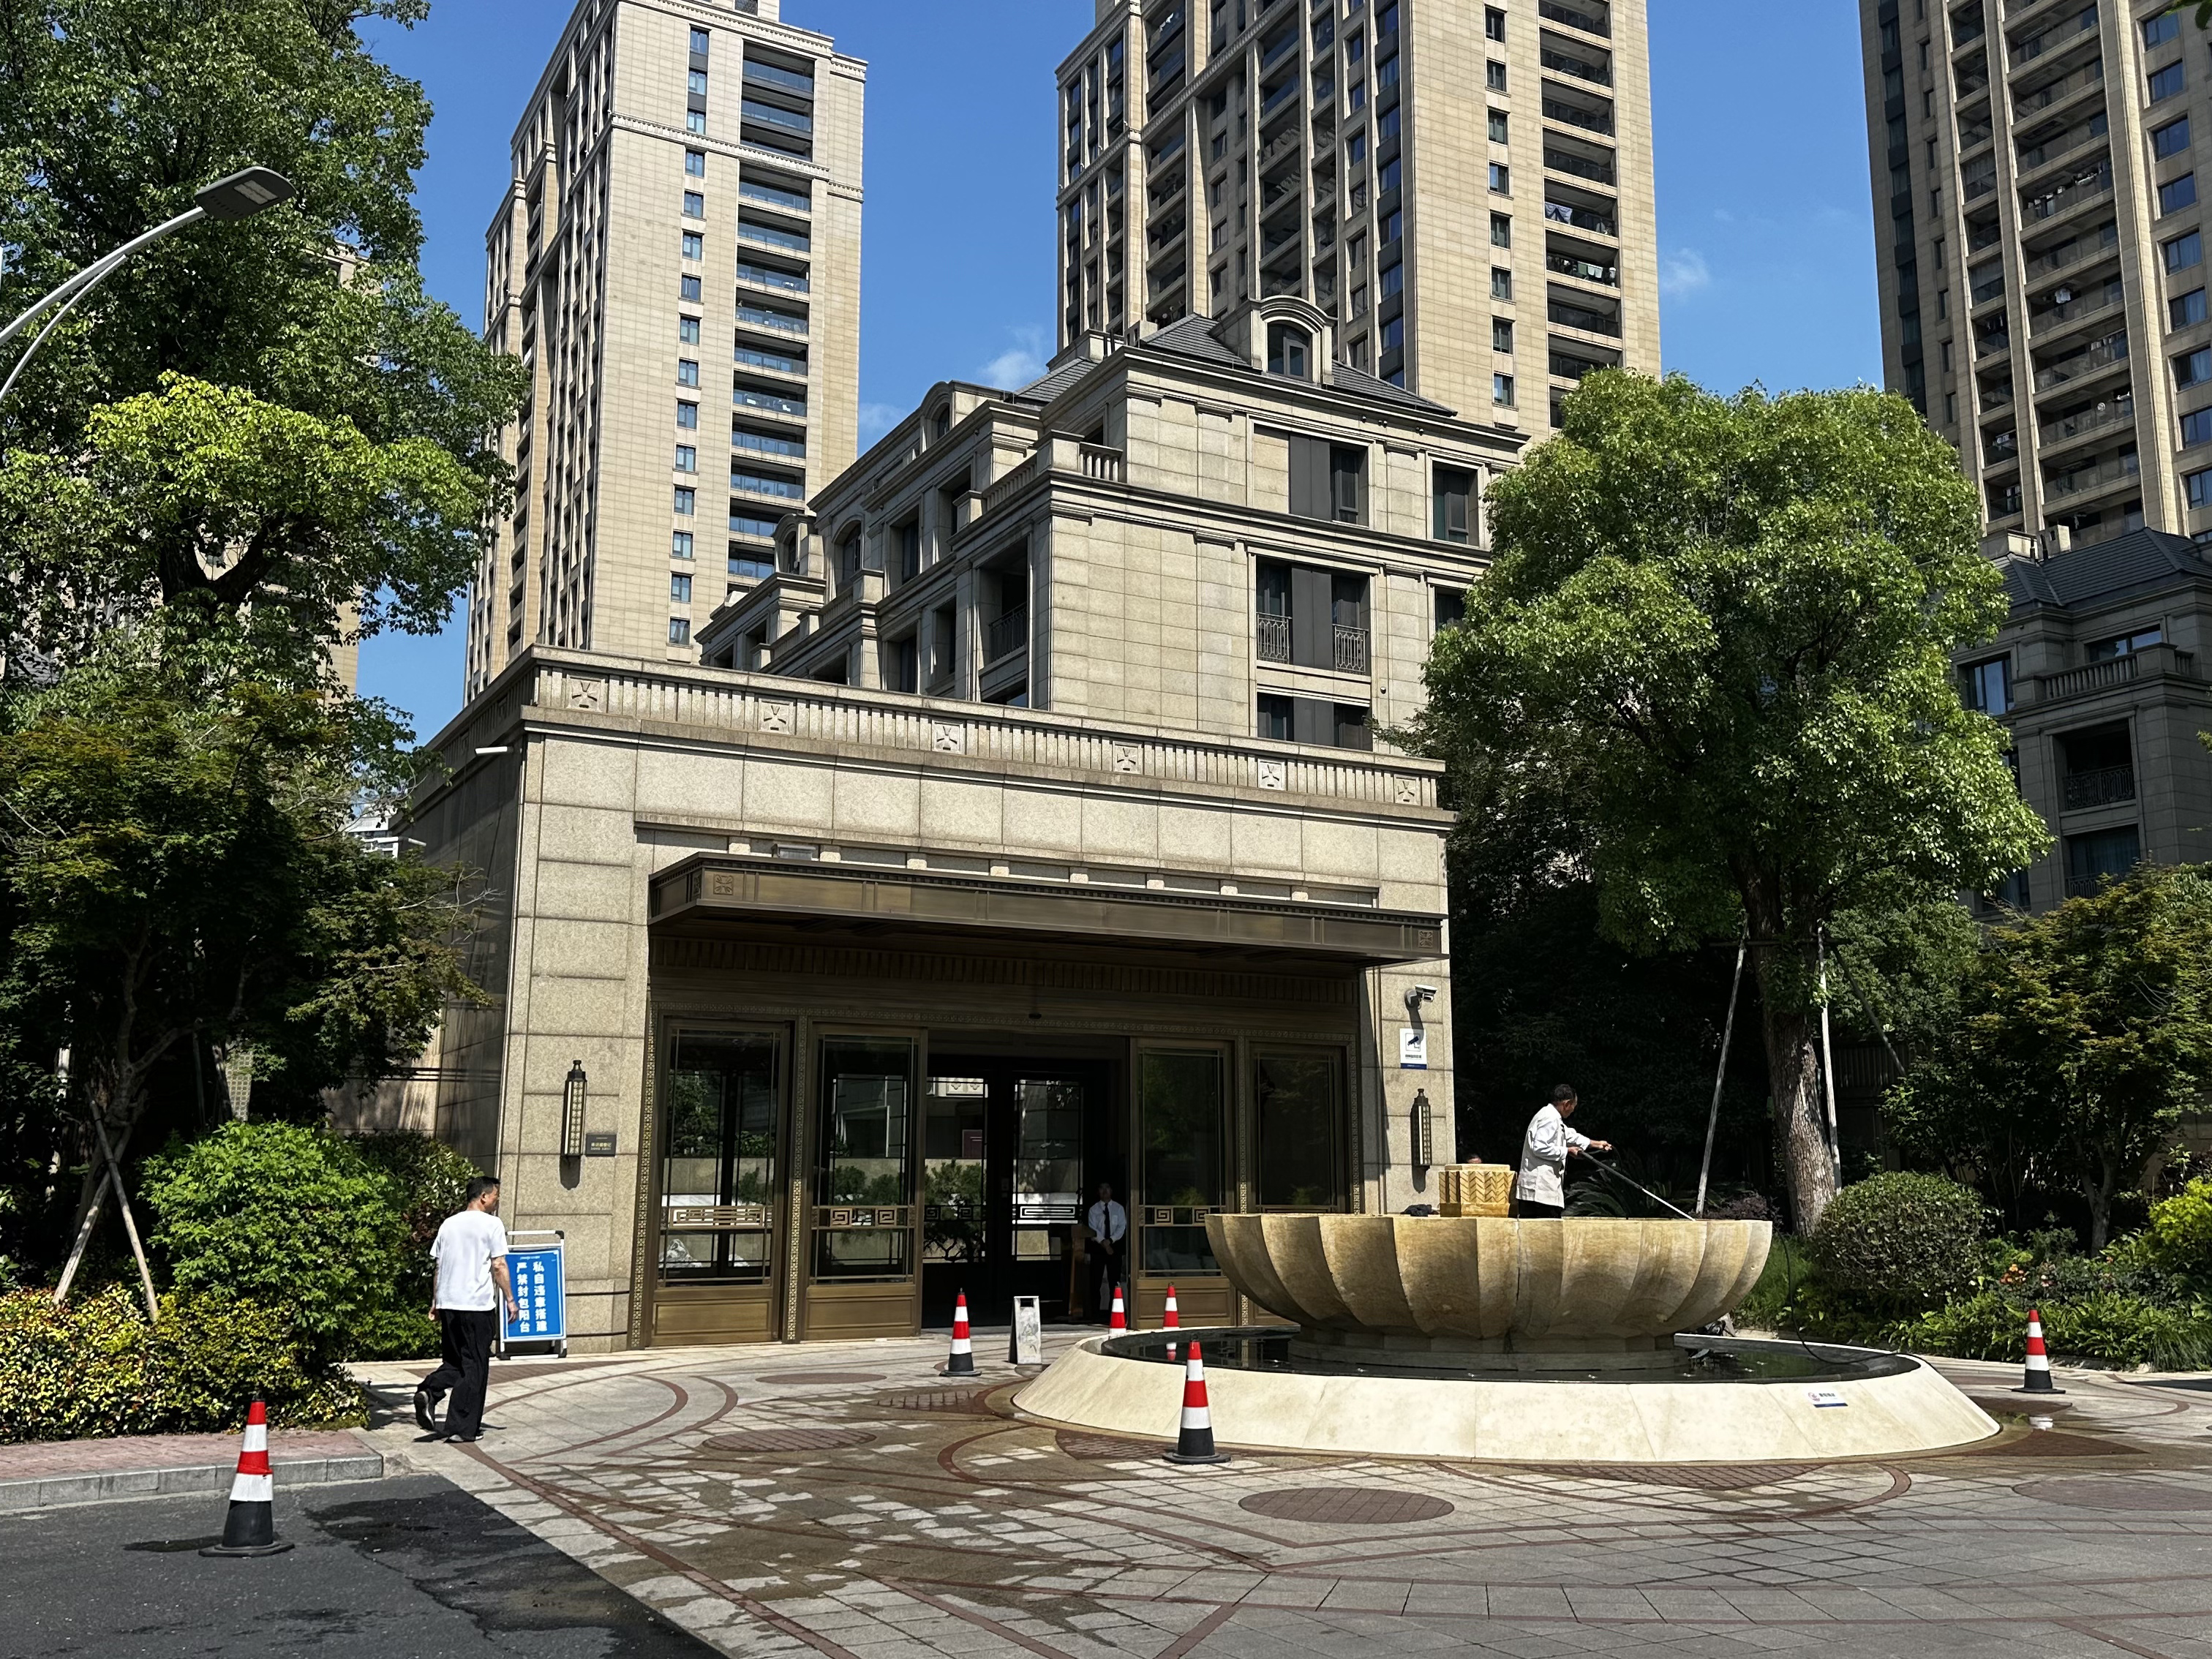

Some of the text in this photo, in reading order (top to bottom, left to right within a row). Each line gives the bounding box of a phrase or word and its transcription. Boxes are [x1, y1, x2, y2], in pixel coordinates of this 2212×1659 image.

[516, 1262, 530, 1333] 严禁封包阳台
[533, 1261, 547, 1332] 私自违章搭建
